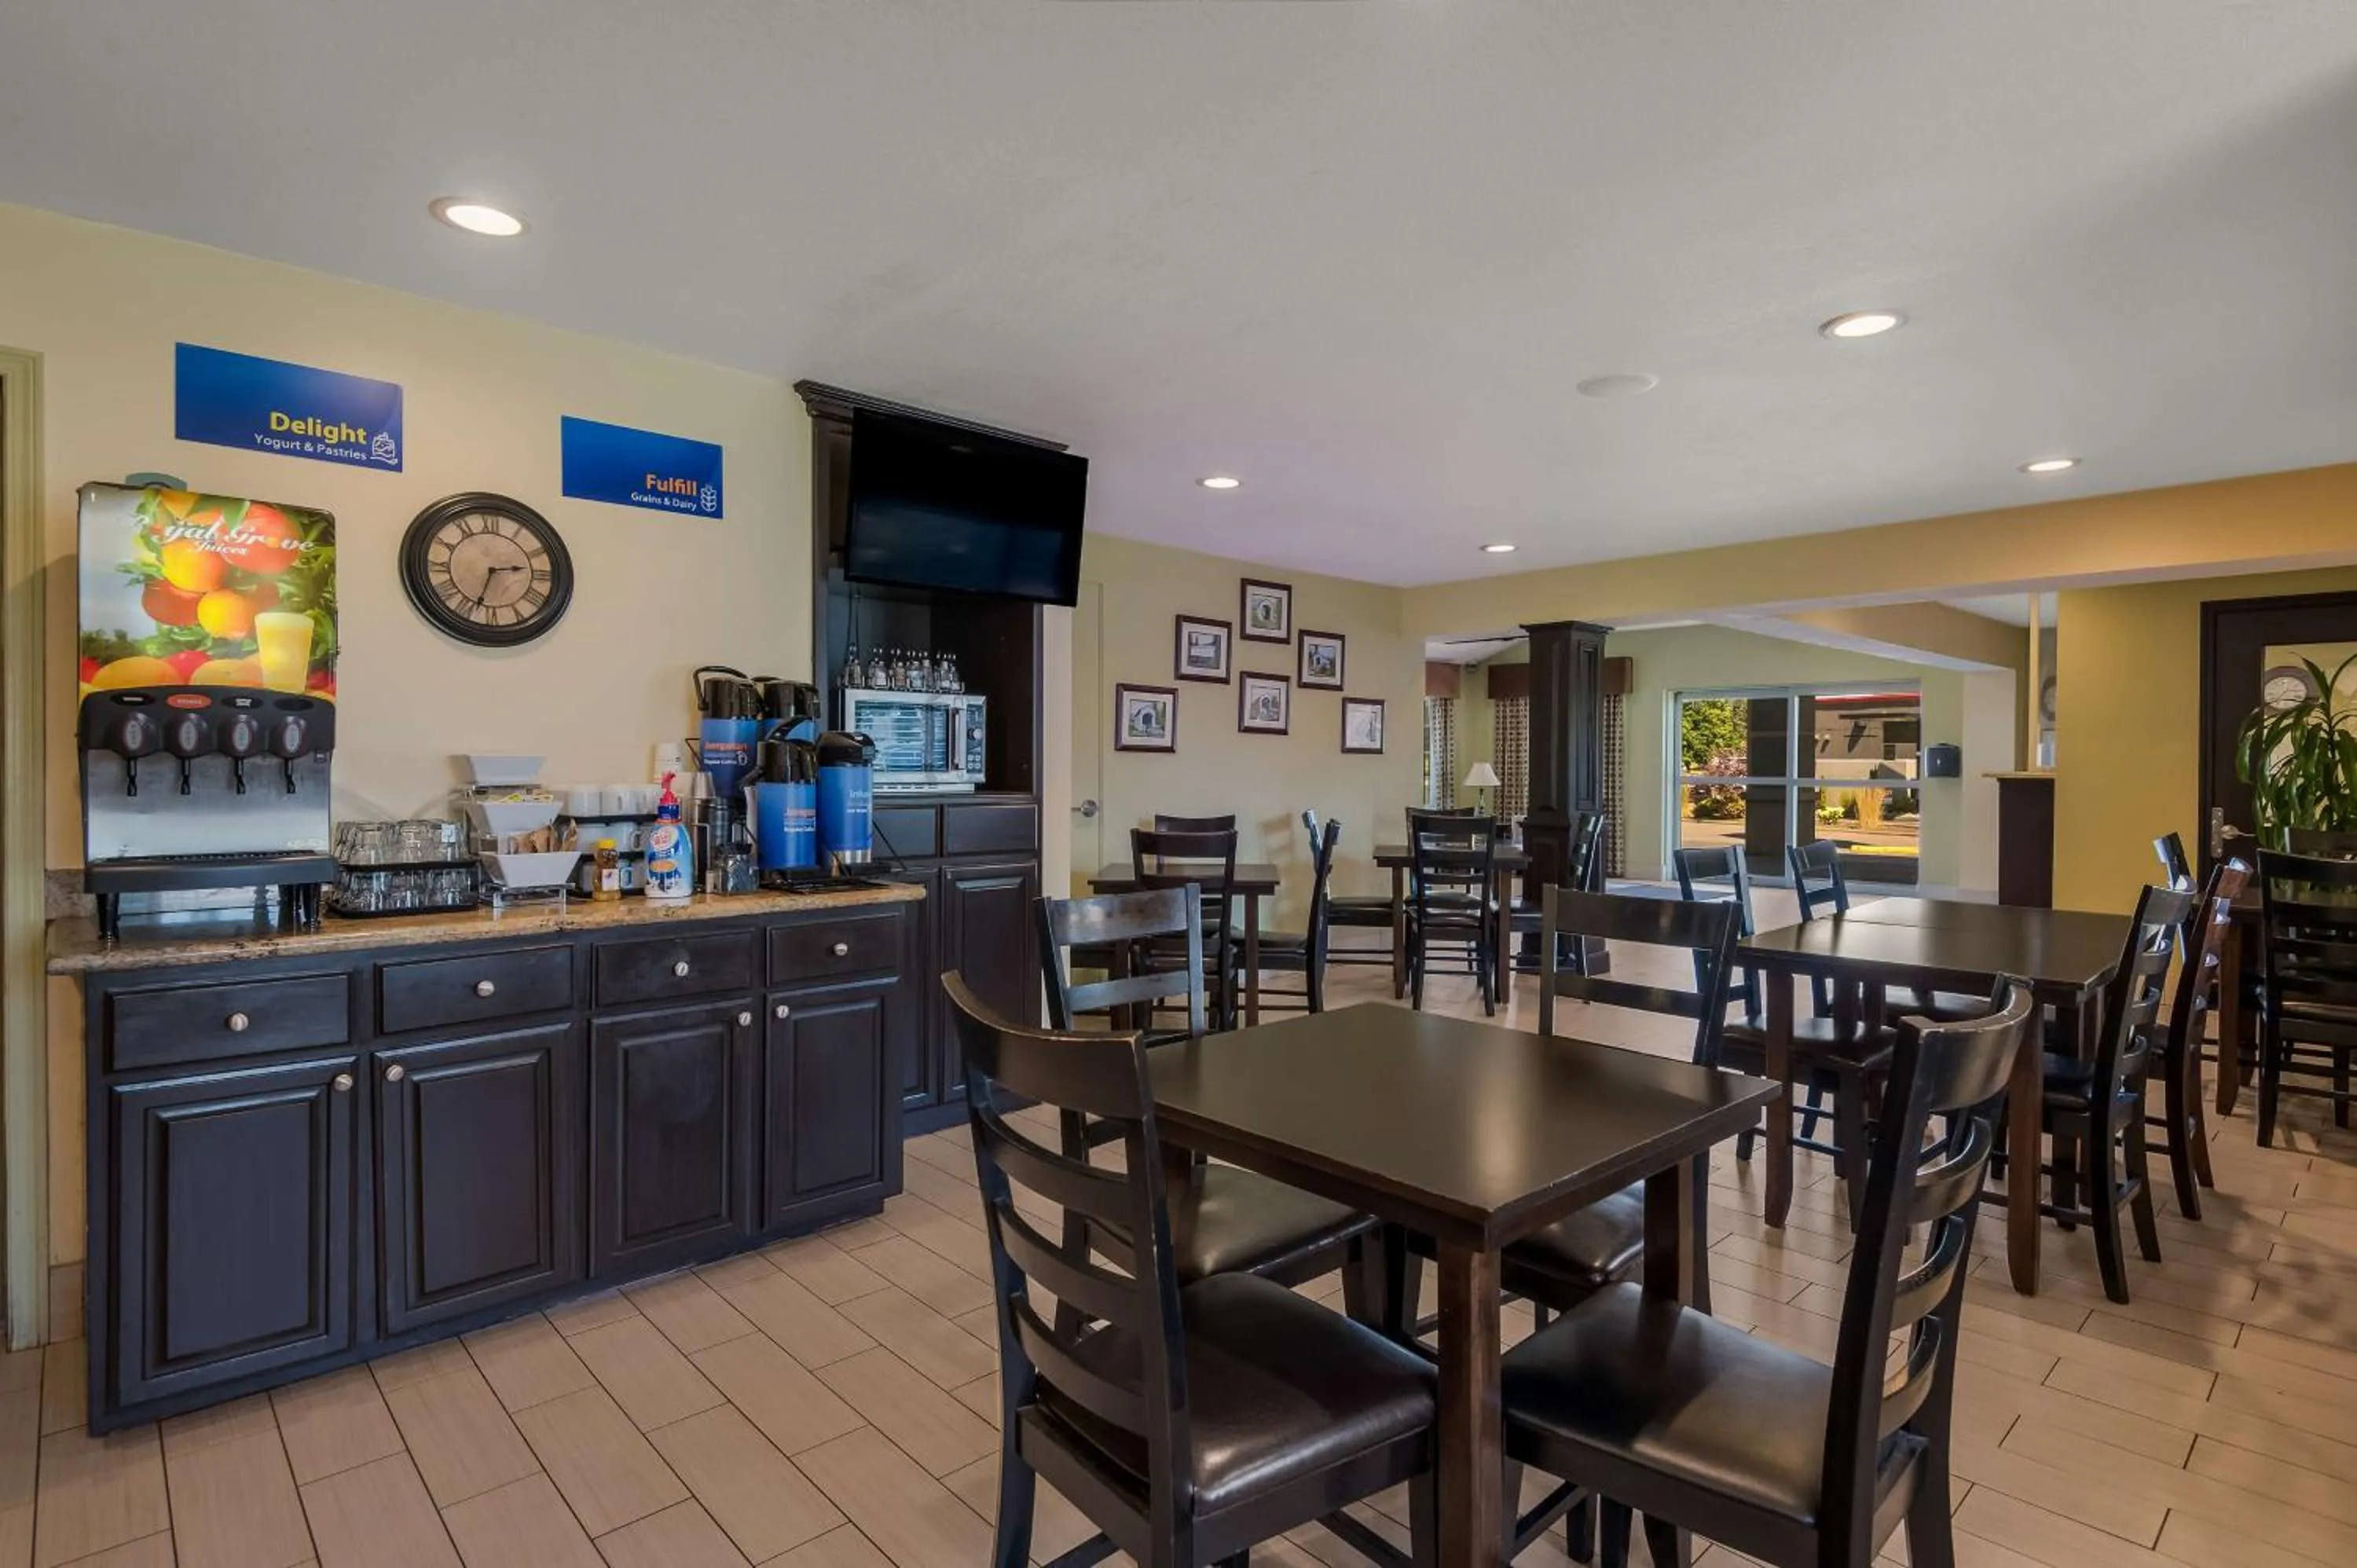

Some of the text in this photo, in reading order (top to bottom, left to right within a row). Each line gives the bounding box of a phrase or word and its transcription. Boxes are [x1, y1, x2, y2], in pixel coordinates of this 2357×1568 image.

[269, 411, 367, 445] Delight
[254, 433, 367, 460] Yogurt & Pastries
[646, 474, 697, 496] Fulfill
[631, 491, 697, 511] Grains & Dairy
